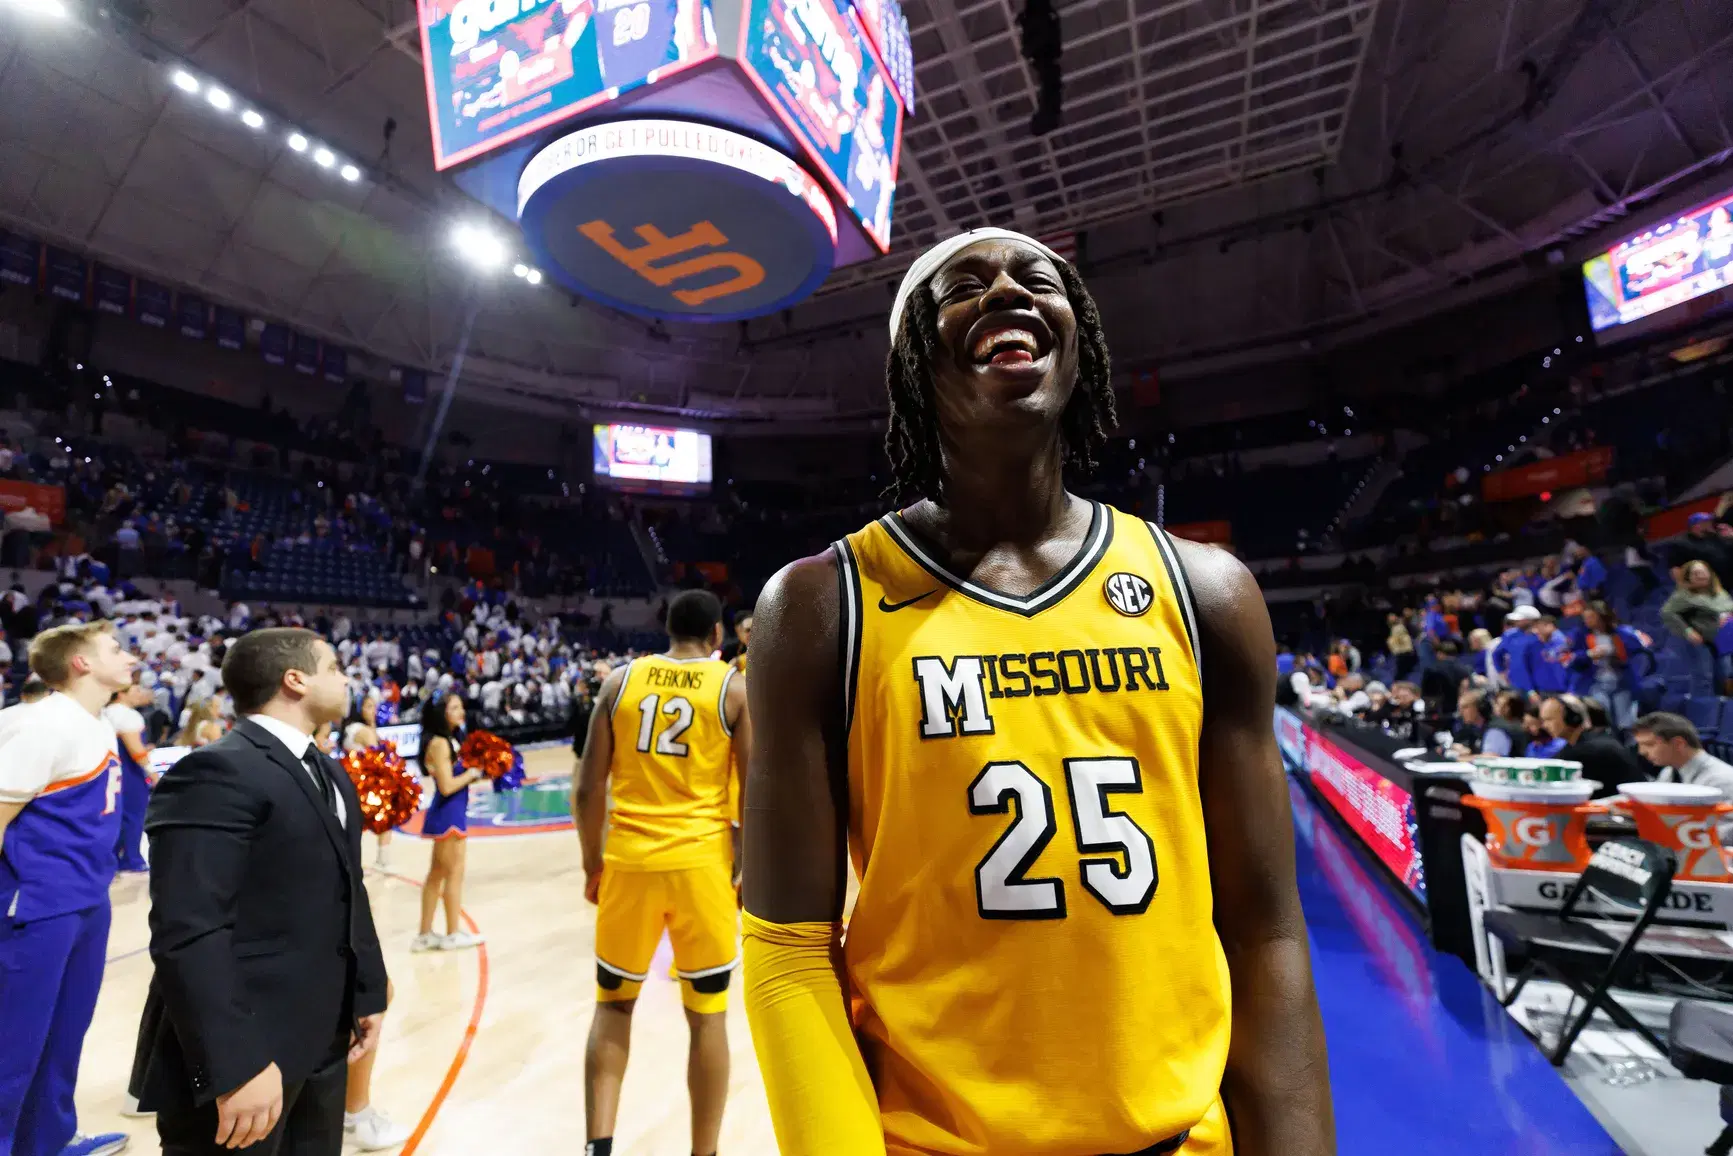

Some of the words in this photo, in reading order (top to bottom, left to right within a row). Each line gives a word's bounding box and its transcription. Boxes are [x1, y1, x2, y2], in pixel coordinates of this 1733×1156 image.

[575, 133, 598, 157] OR
[604, 128, 638, 151] GET
[644, 127, 719, 153] PULLED
[576, 219, 765, 306] UF
[1107, 573, 1151, 612] SEC
[646, 666, 704, 690] PERKINS
[912, 647, 1170, 739] MISSOURI
[636, 693, 695, 757] 12
[967, 756, 1160, 920] 25
[1516, 817, 1551, 847] G
[1676, 821, 1712, 849] G
